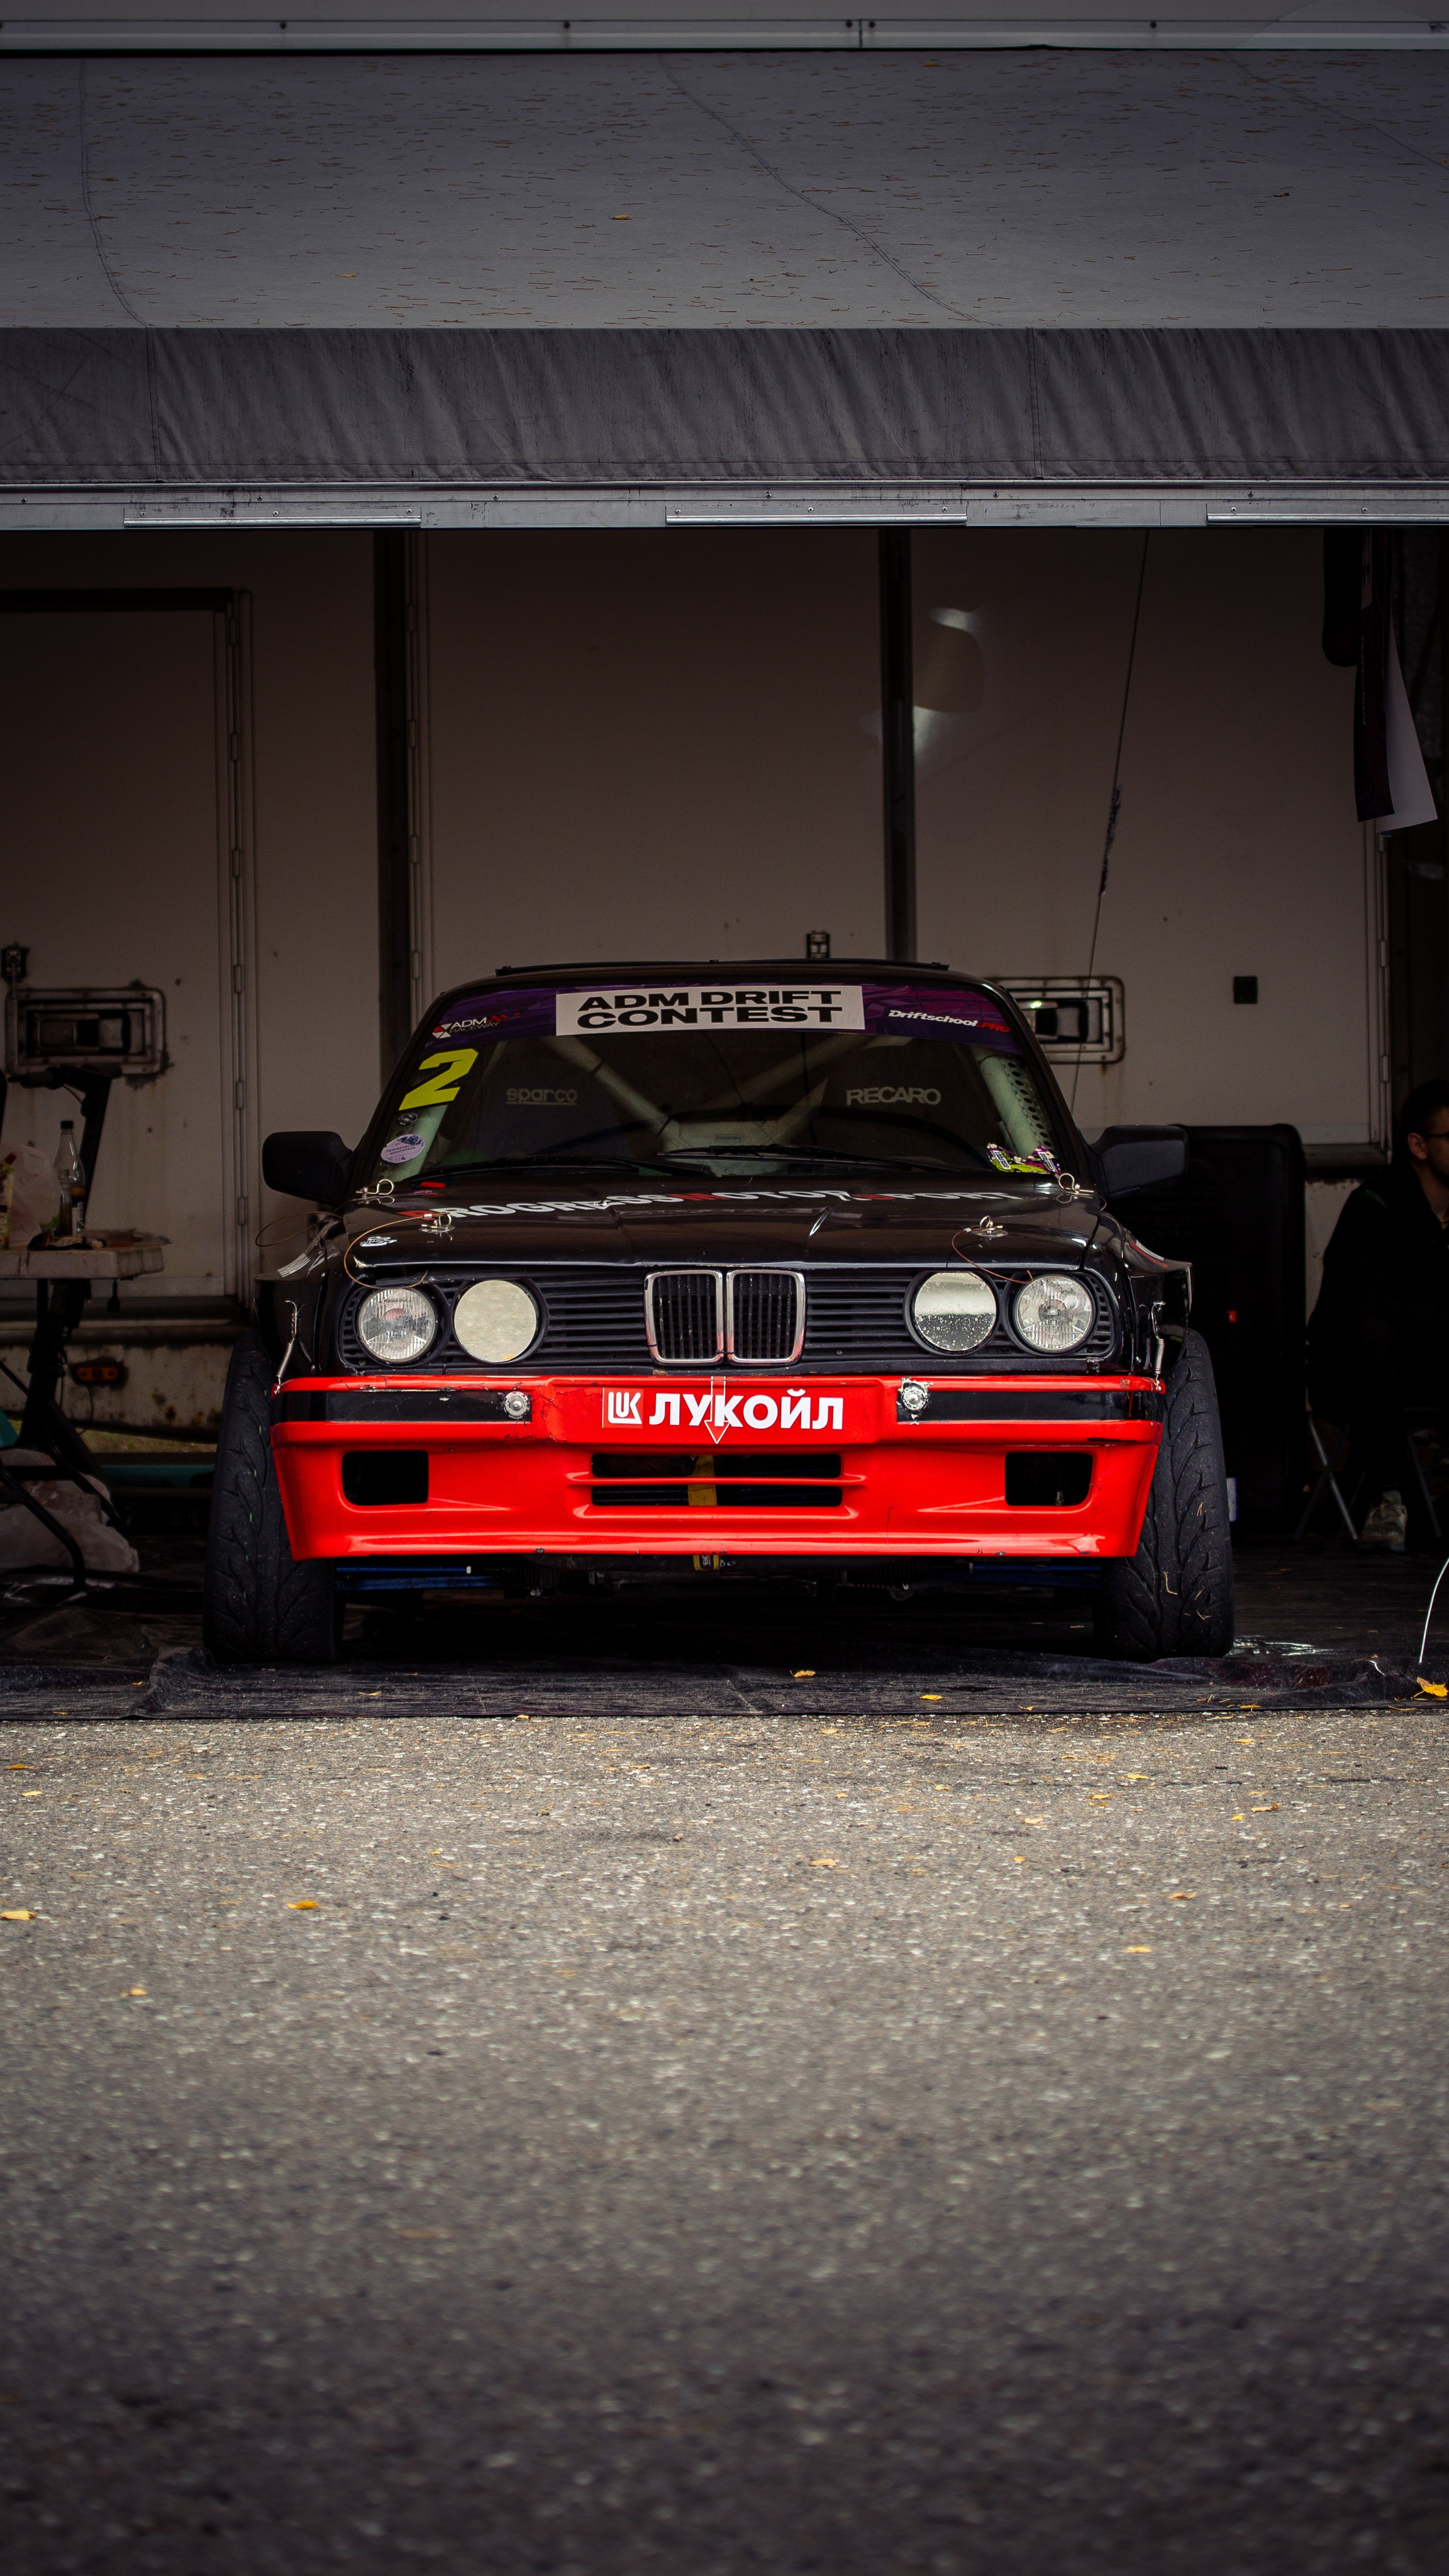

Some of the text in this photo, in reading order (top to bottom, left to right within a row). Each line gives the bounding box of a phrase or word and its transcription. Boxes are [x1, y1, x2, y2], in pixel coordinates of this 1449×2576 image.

[577, 991, 841, 1011] ADM DRIFT
[450, 1017, 487, 1030] ADM
[450, 1021, 500, 1033] RACEWAY
[577, 1006, 843, 1029] CONTEST
[398, 1048, 479, 1111] 2
[506, 1087, 578, 1105] sparco
[846, 1086, 941, 1106] RECARO
[648, 1388, 843, 1430] ЛУКОЙЛ
